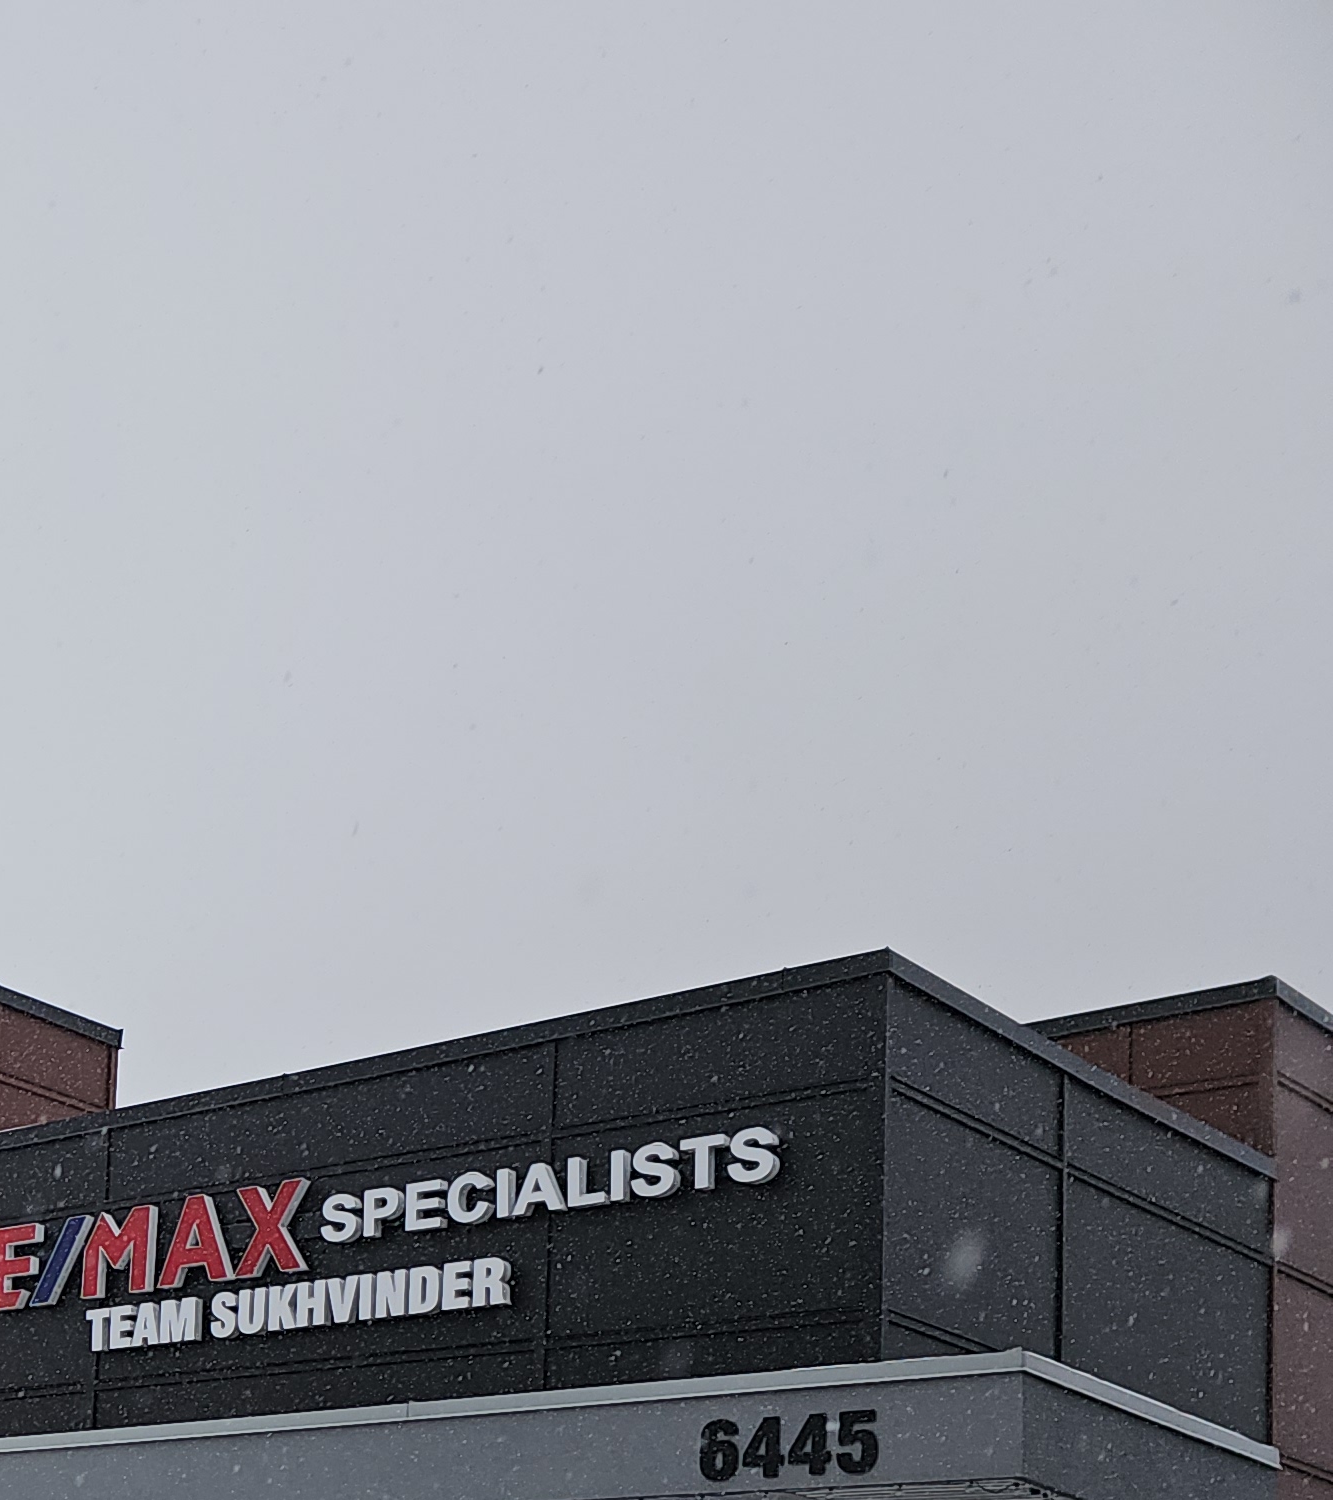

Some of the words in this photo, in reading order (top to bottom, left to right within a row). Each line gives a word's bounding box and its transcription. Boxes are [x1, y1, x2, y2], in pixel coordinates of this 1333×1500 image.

[320, 1126, 780, 1242] SPECIALISTS
[86, 1298, 202, 1352] TEAM
[209, 1257, 511, 1340] SUKHVINDER
[698, 1410, 878, 1482] 6445
